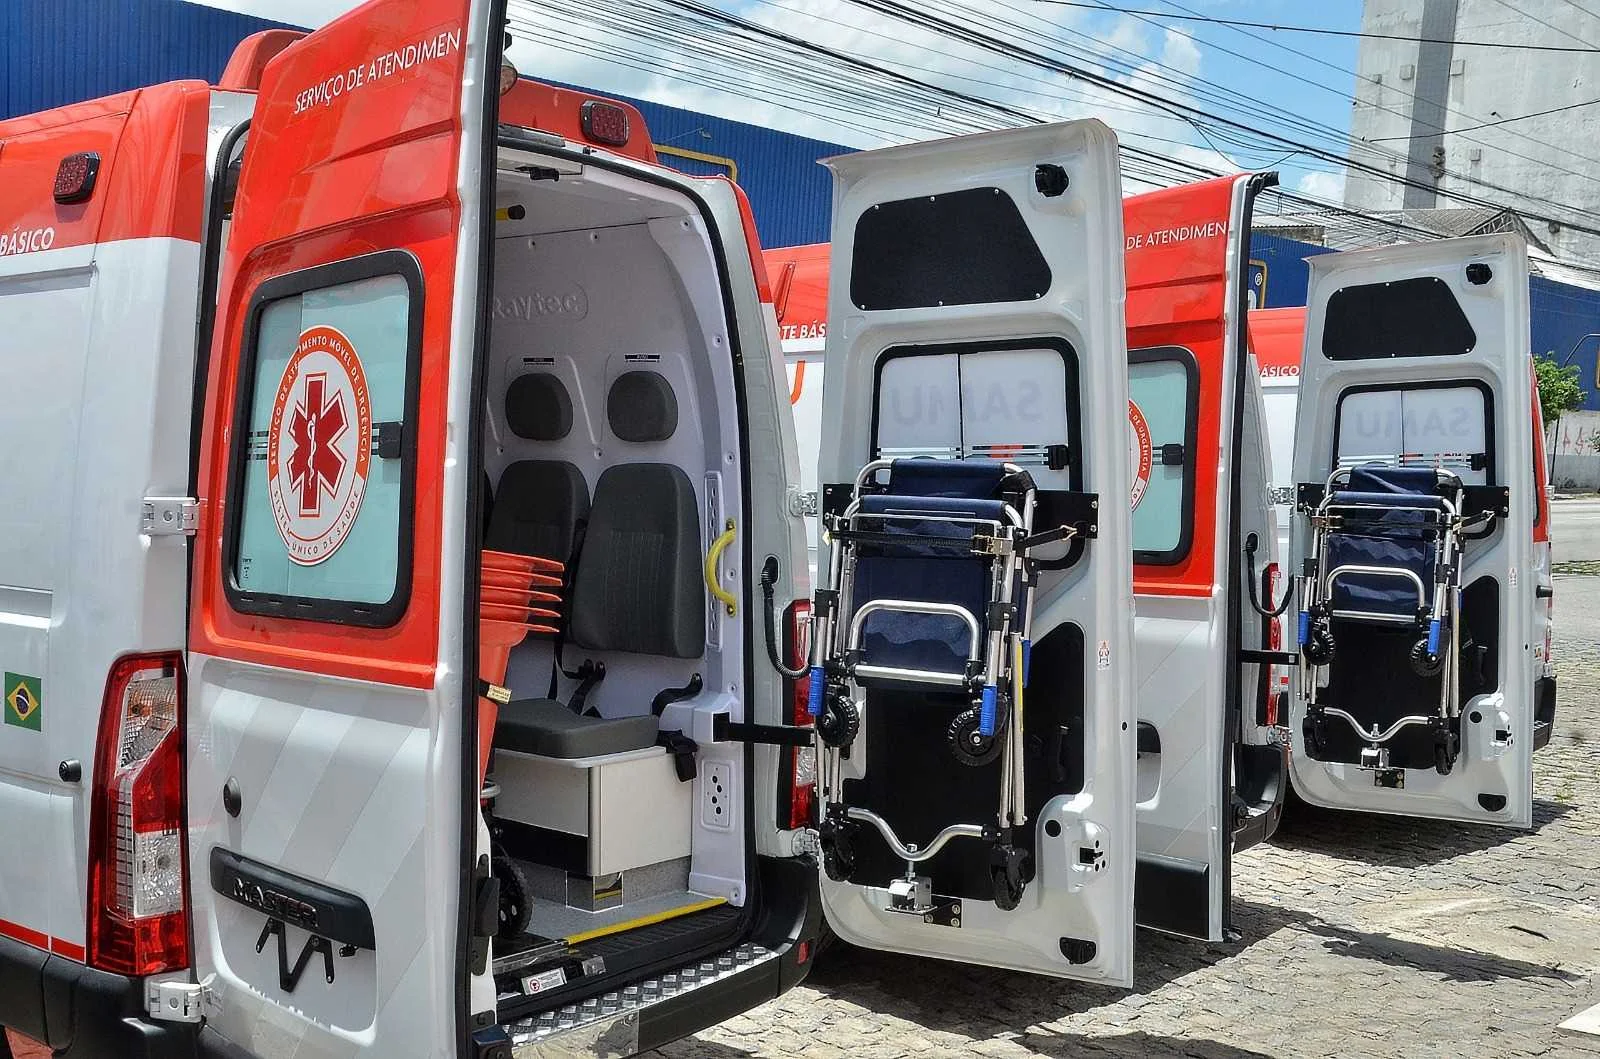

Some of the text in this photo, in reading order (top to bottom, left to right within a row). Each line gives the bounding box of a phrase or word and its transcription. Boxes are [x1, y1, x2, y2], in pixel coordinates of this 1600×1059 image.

[294, 28, 462, 115] SERVIÇO DE ATENDIMEN
[0, 226, 55, 256] BÁSICO
[1126, 221, 1227, 250] DE ATENDIMEN
[800, 319, 826, 338] BÁS
[351, 367, 360, 385] DE
[233, 876, 319, 928] MASTER
